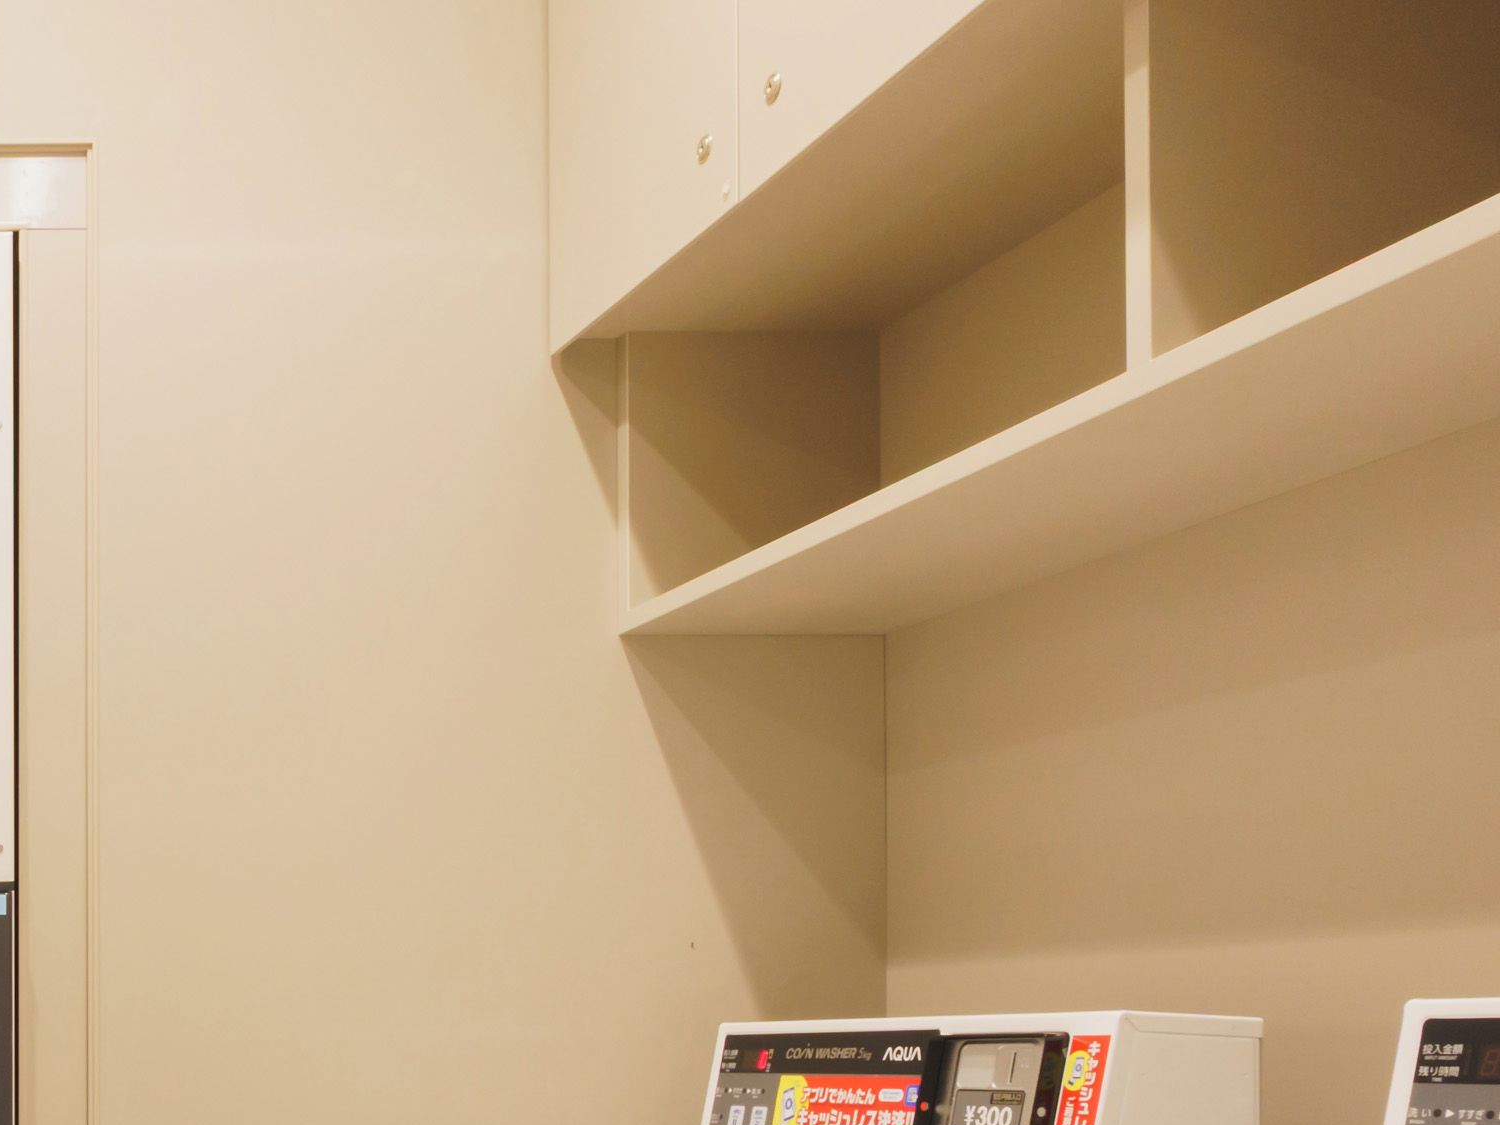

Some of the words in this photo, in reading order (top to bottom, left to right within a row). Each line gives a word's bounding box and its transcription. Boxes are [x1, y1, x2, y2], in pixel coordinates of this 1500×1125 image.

[815, 1048, 857, 1059] WASHER
[882, 1046, 921, 1061] AQUA
[1422, 1044, 1464, 1055] 投入金額
[1418, 1066, 1460, 1077] 残り時間
[802, 1088, 875, 1105] アプリでかんたん
